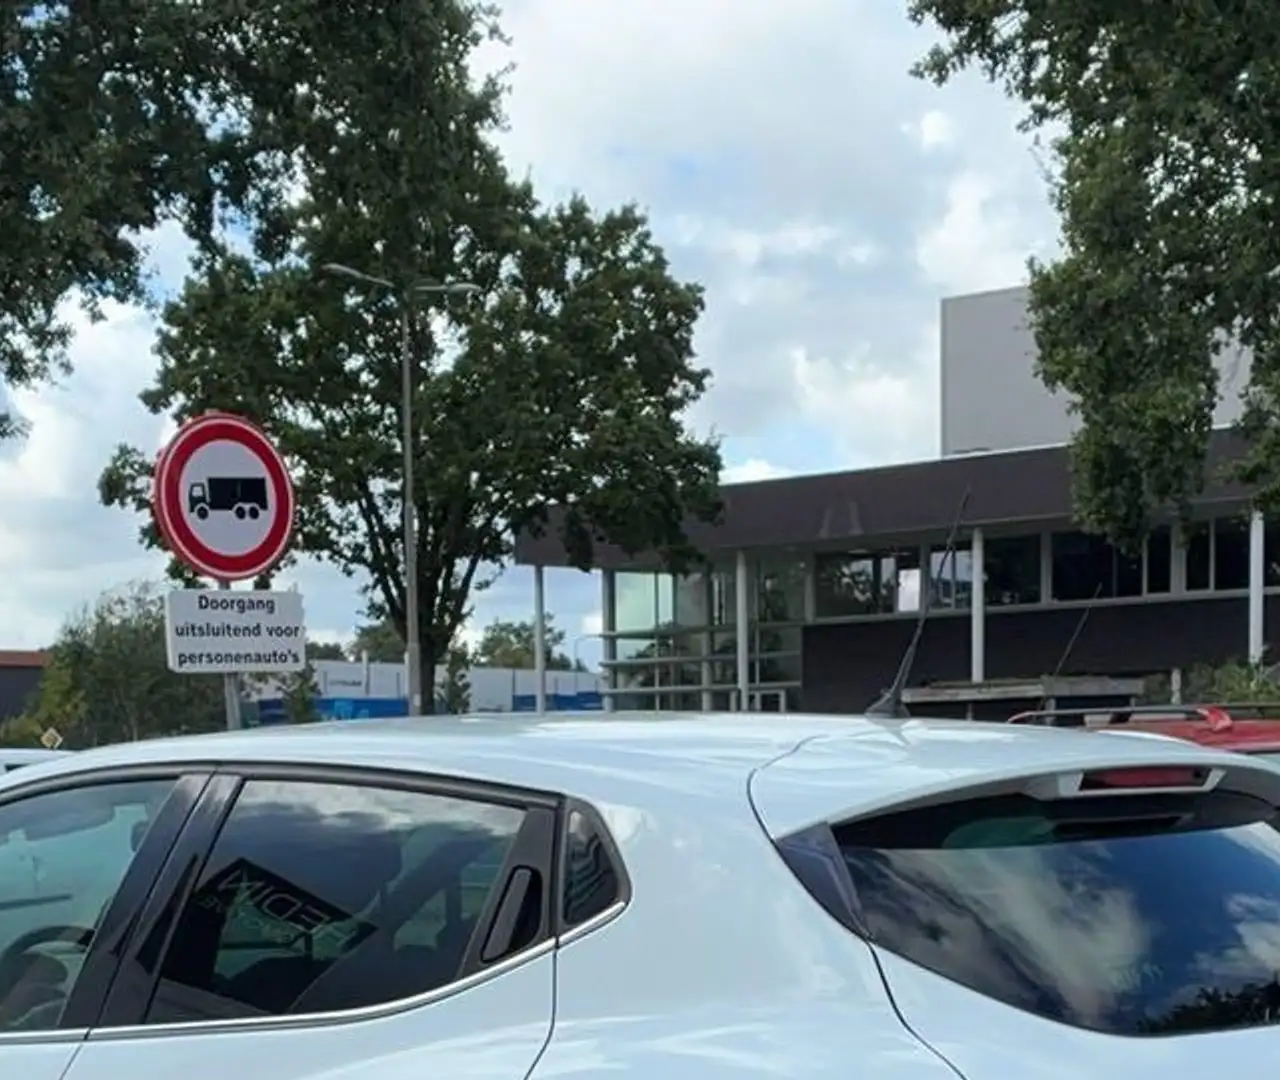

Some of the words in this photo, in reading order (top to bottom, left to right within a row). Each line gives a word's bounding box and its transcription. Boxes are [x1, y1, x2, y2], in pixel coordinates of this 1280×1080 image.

[198, 595, 275, 613] Doorgang
[176, 622, 261, 637] uitsluitend
[266, 625, 299, 637] voor
[178, 650, 299, 667] personenauto's
